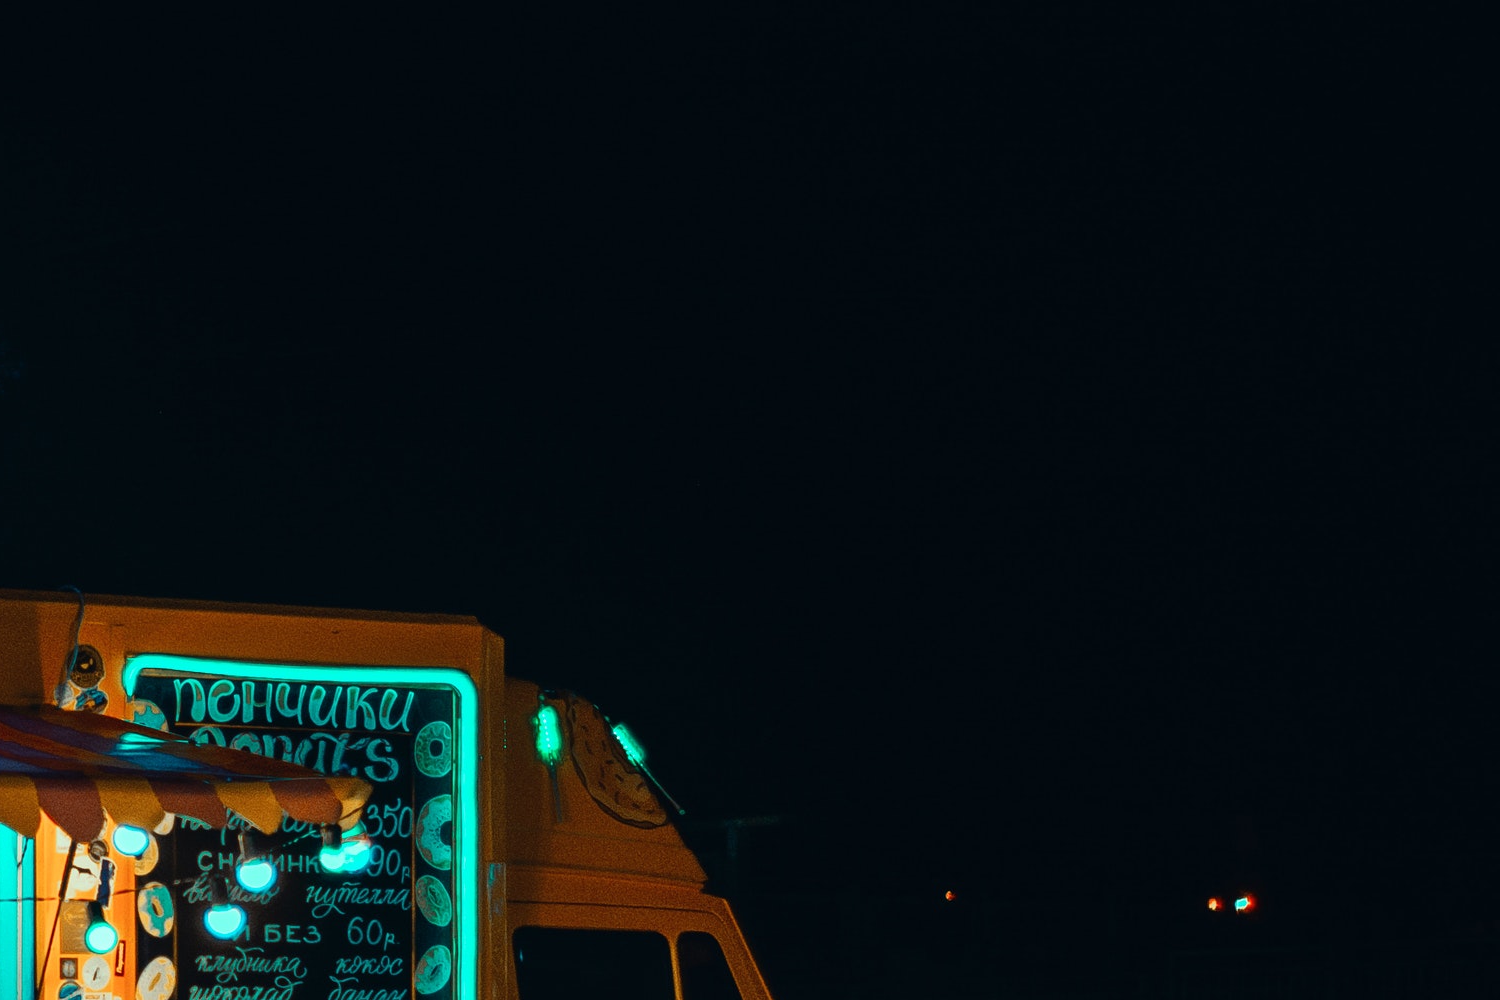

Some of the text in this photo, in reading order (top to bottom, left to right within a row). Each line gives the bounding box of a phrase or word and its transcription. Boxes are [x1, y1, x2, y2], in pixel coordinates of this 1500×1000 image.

[263, 923, 322, 944] БЕЗ
[194, 946, 404, 983] клубника кокос
